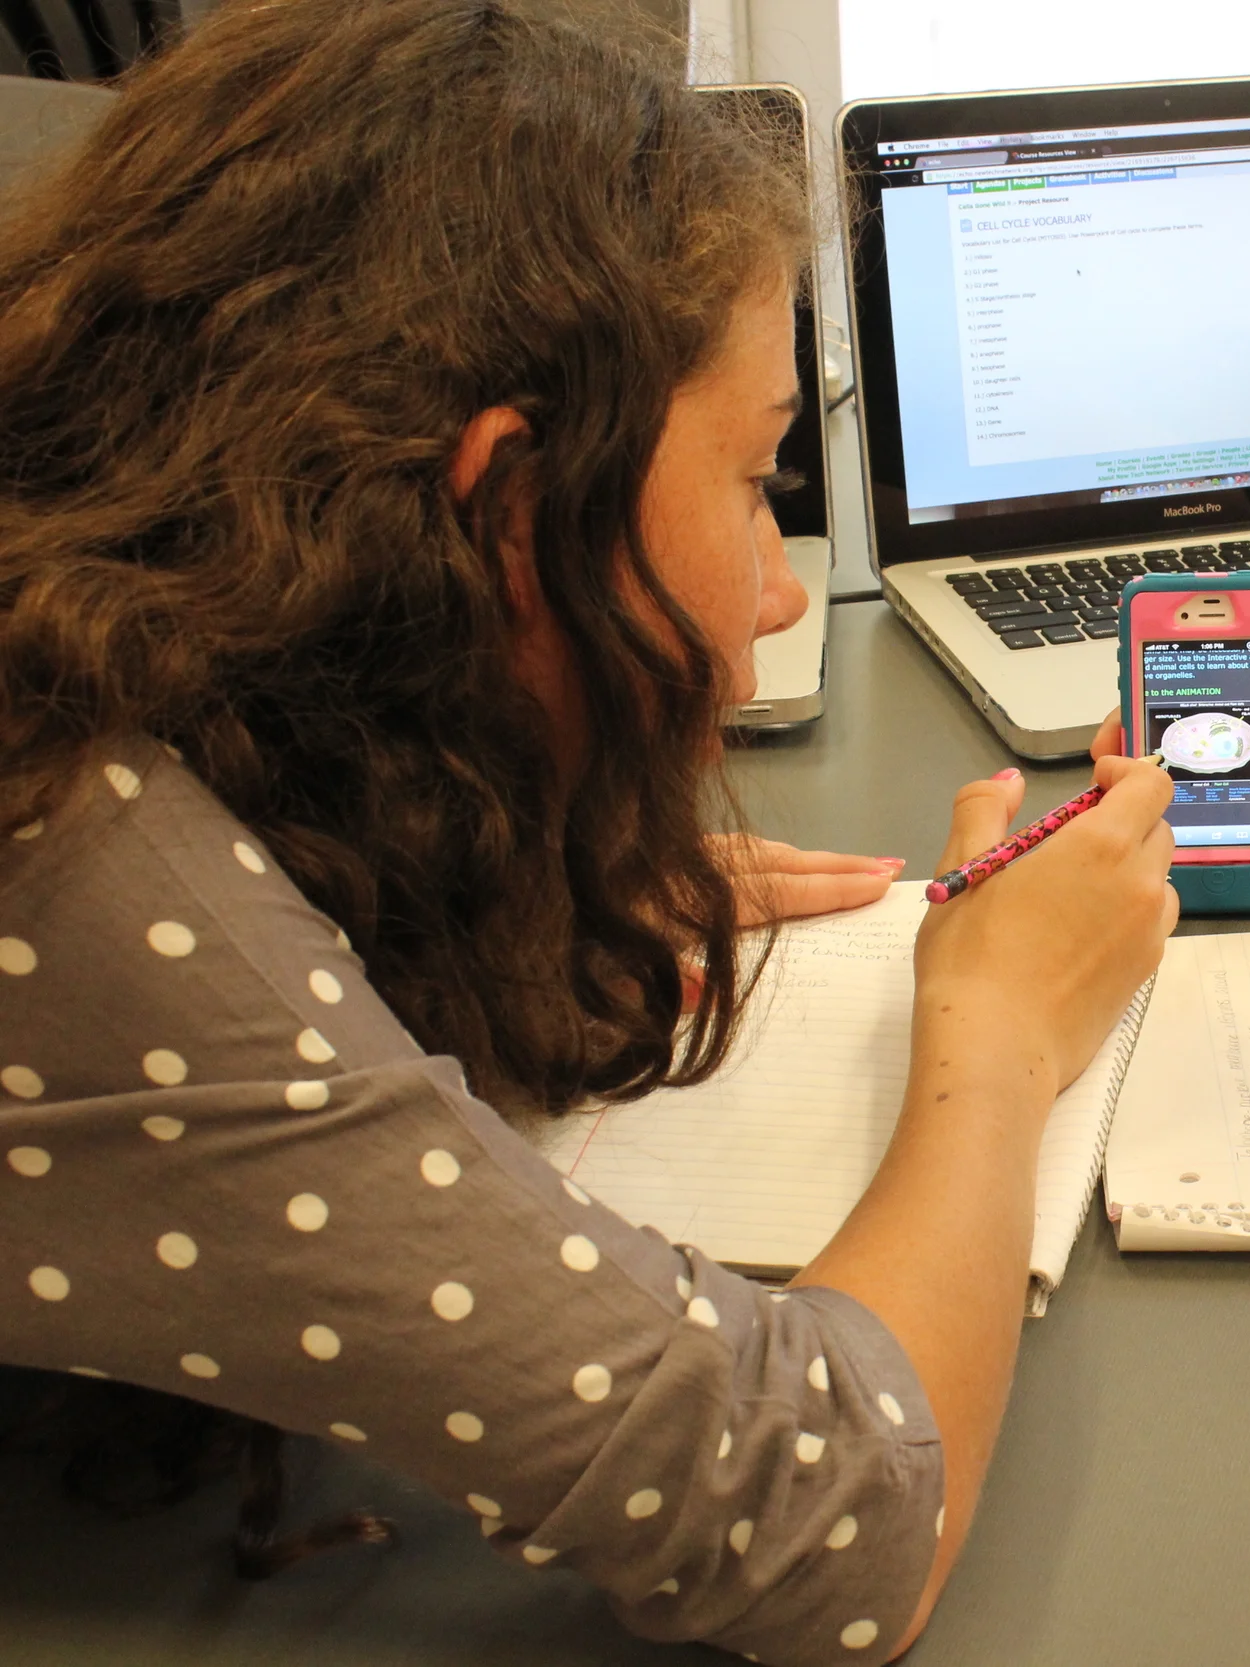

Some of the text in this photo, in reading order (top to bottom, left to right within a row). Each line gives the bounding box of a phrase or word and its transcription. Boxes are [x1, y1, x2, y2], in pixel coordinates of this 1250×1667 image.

[904, 142, 930, 150] Chrome
[1031, 132, 1065, 140] Bookmarks
[1072, 130, 1096, 138] Window
[1104, 129, 1118, 137] Help
[950, 182, 968, 190] Start
[976, 181, 1005, 189] Agendas
[1014, 178, 1042, 187] Projects
[1018, 198, 1040, 206] Project
[1042, 196, 1069, 204] Resource
[977, 213, 1092, 231] CELL CYCLE VOCABULARY
[962, 240, 991, 248] Vocabulary
[988, 431, 1026, 439] Chromosomes
[1221, 446, 1240, 454] People
[1130, 471, 1144, 479] Tech
[1146, 468, 1170, 476] Network
[1164, 503, 1222, 518] MacBook Pro
[1158, 655, 1175, 663] size.
[1177, 654, 1191, 662] Use
[1193, 654, 1206, 662] the
[1207, 653, 1247, 662] Interactive
[1152, 663, 1177, 671] animal
[1179, 662, 1195, 671] cells
[1207, 662, 1226, 670] learn
[1228, 661, 1249, 669] about
[1155, 671, 1196, 681] organelles.
[1161, 688, 1174, 696] the
[1175, 687, 1222, 696] ANIMATION
